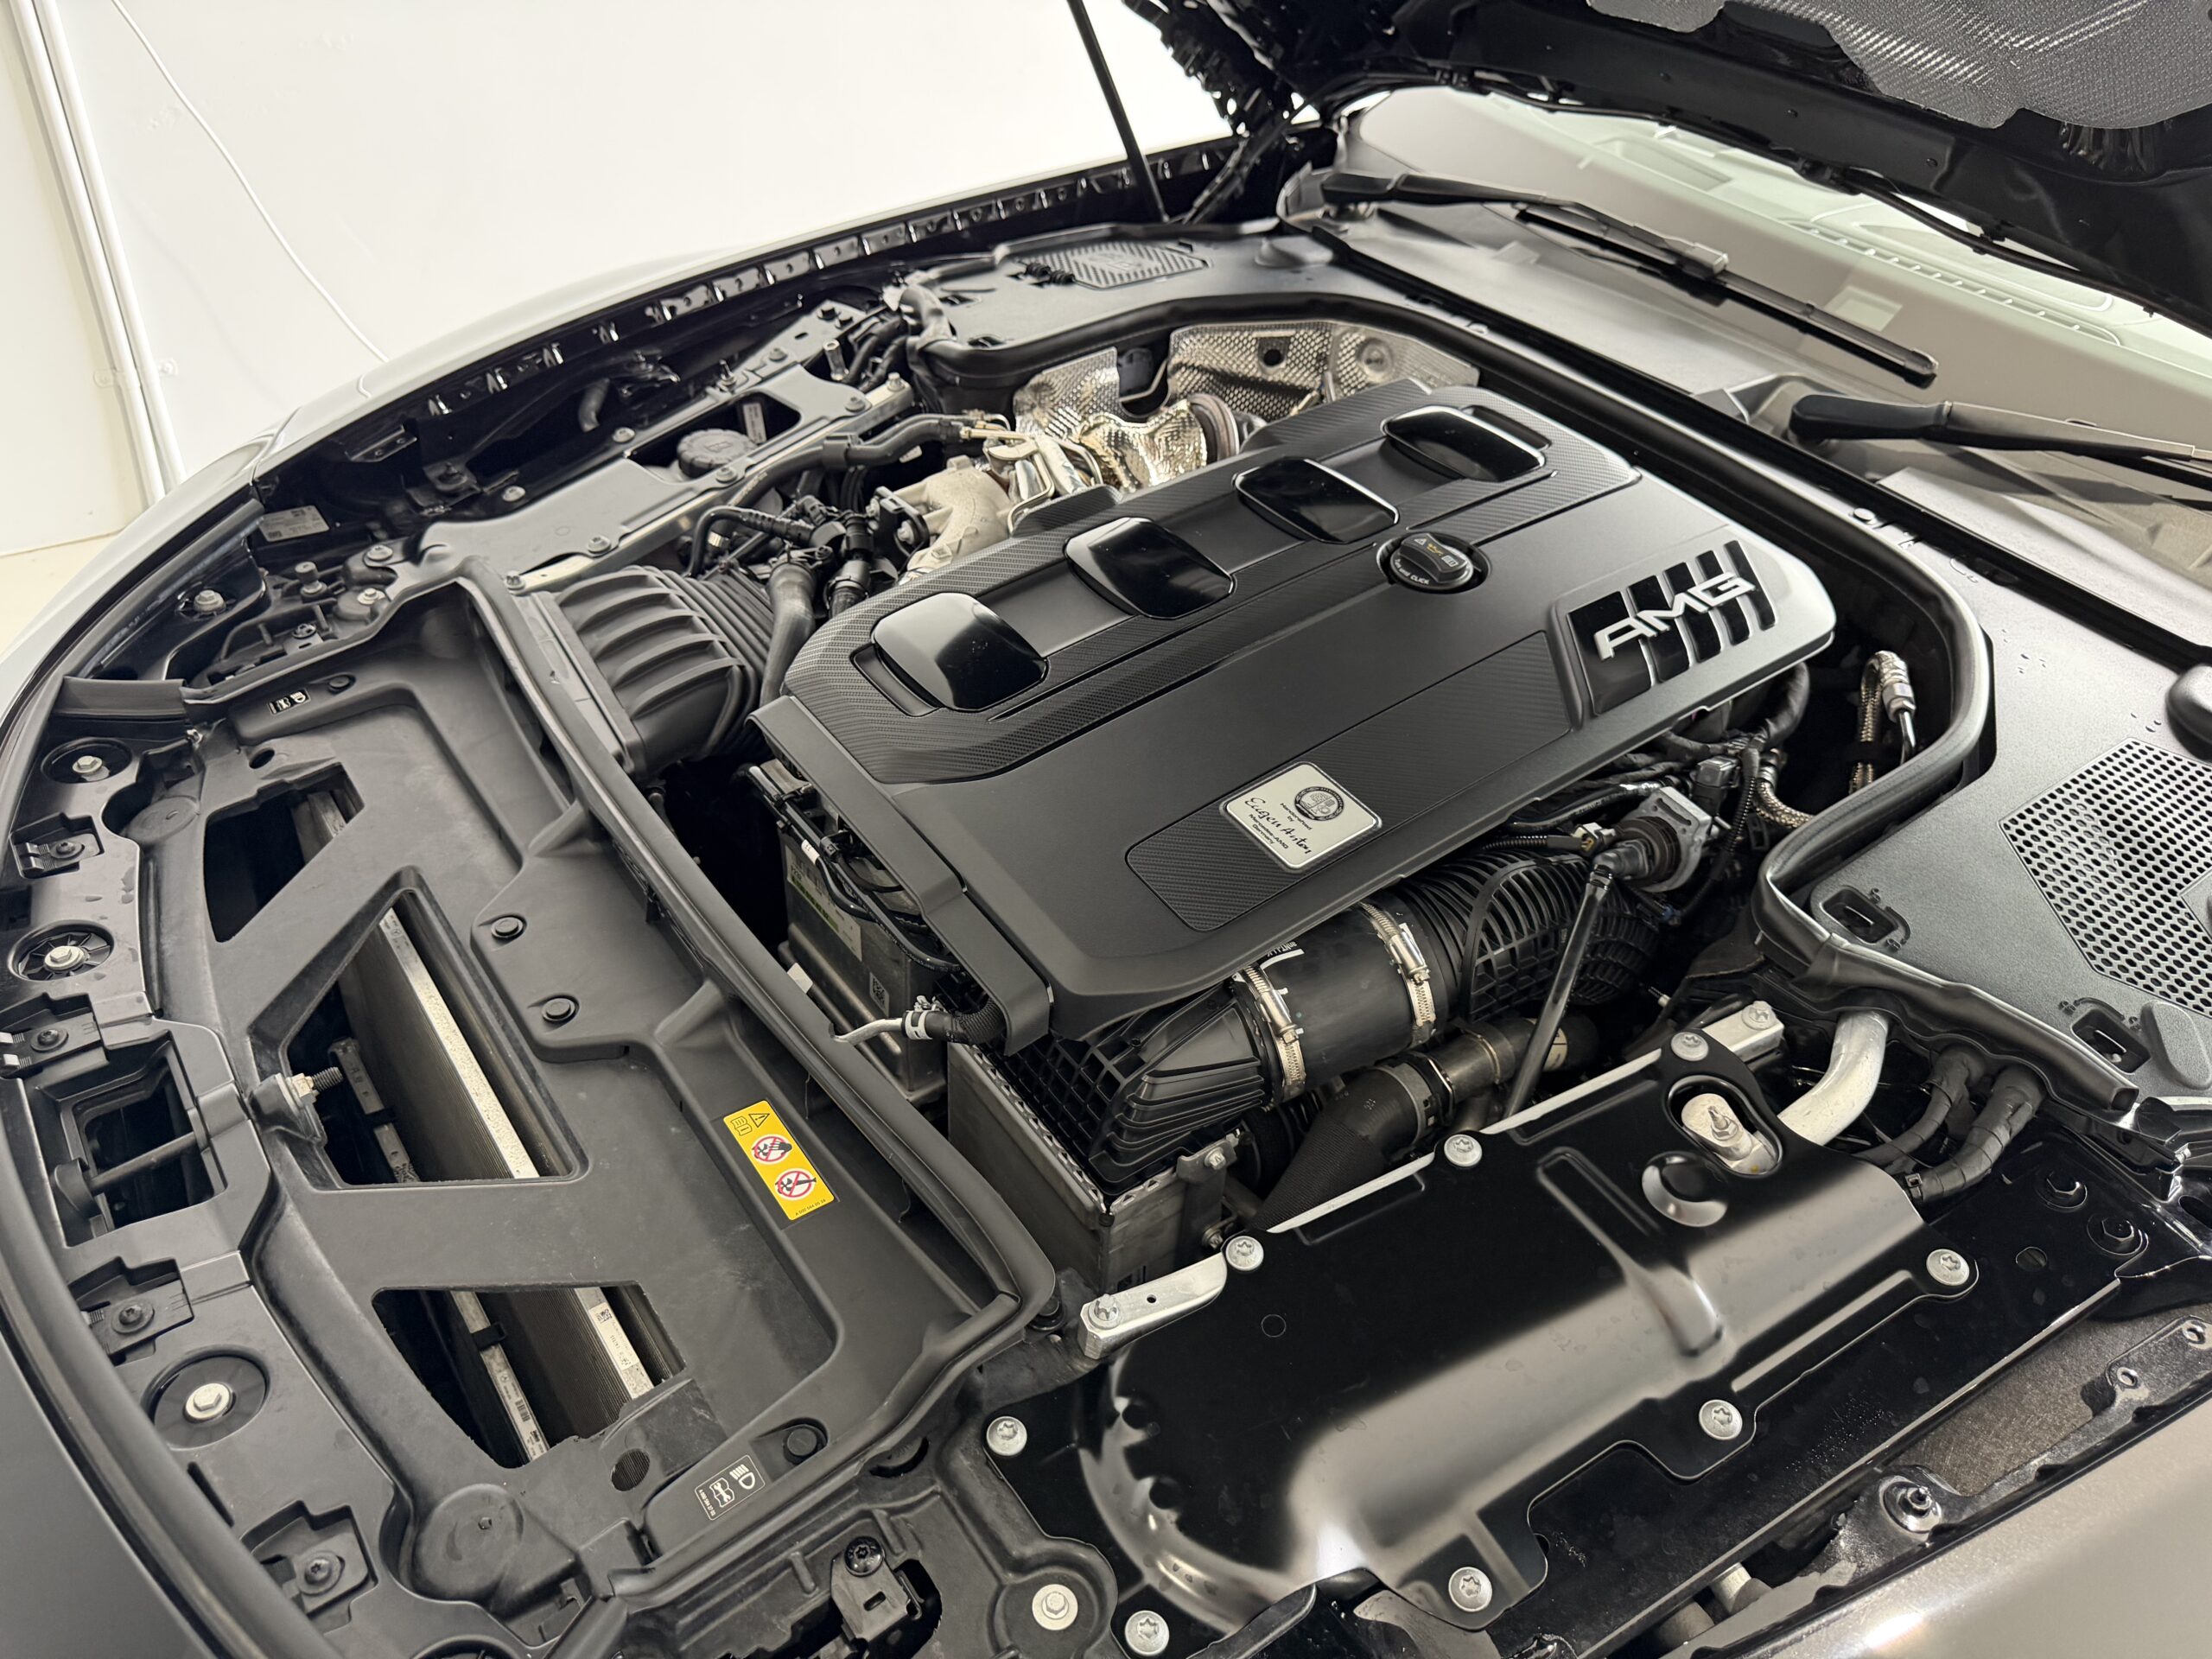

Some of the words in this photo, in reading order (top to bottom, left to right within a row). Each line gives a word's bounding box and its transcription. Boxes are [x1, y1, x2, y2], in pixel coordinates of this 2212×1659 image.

[1410, 575, 1429, 585] CLICK
[1593, 571, 1756, 660] AMG
[1245, 798, 1281, 828] Eugen
[1280, 828, 1312, 854] Anton
[1249, 814, 1288, 849] Mercedes-AMG
[1280, 803, 1313, 830] Handcrafted
[1252, 823, 1274, 844] Germany
